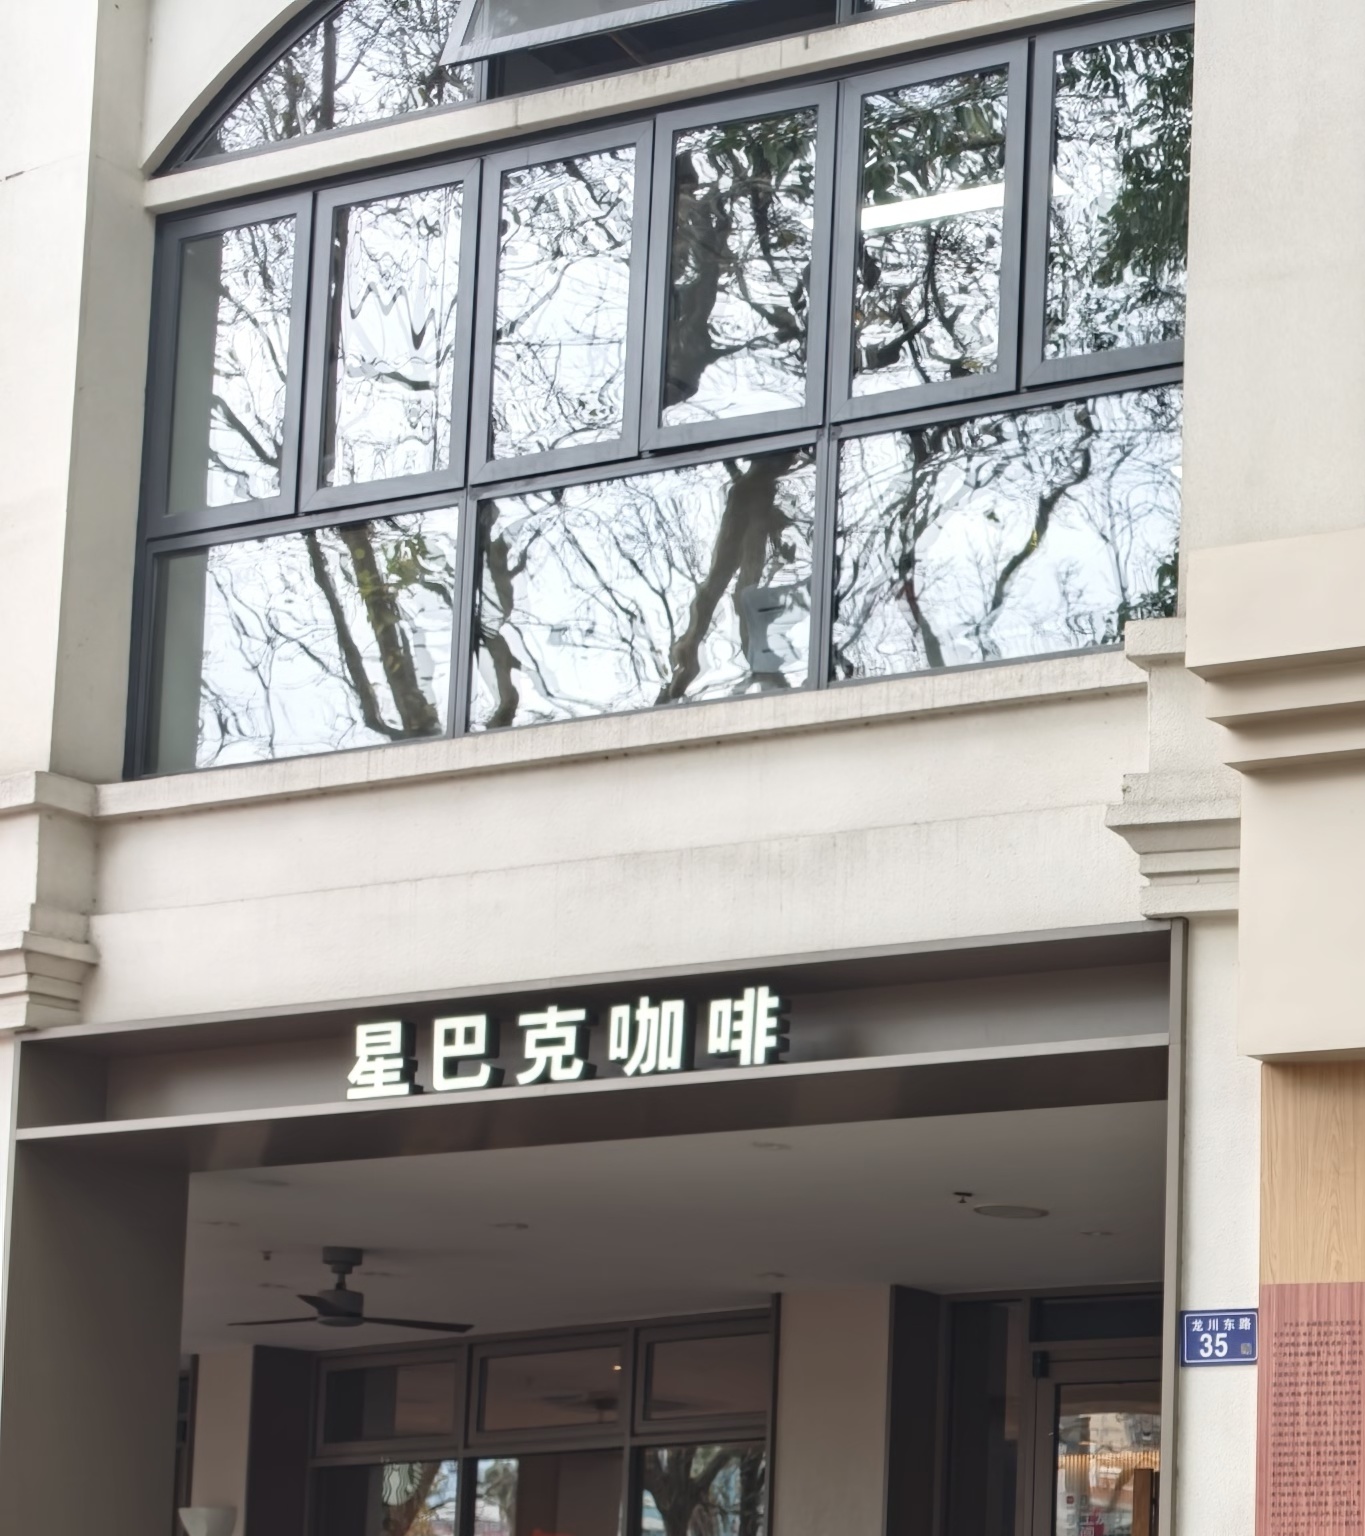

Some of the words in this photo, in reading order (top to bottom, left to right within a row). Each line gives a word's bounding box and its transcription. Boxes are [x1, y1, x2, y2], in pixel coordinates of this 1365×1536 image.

[346, 985, 783, 1100] 星巴克咖啡
[1191, 1316, 1252, 1332] 龙川东路
[1199, 1332, 1228, 1358] 35
